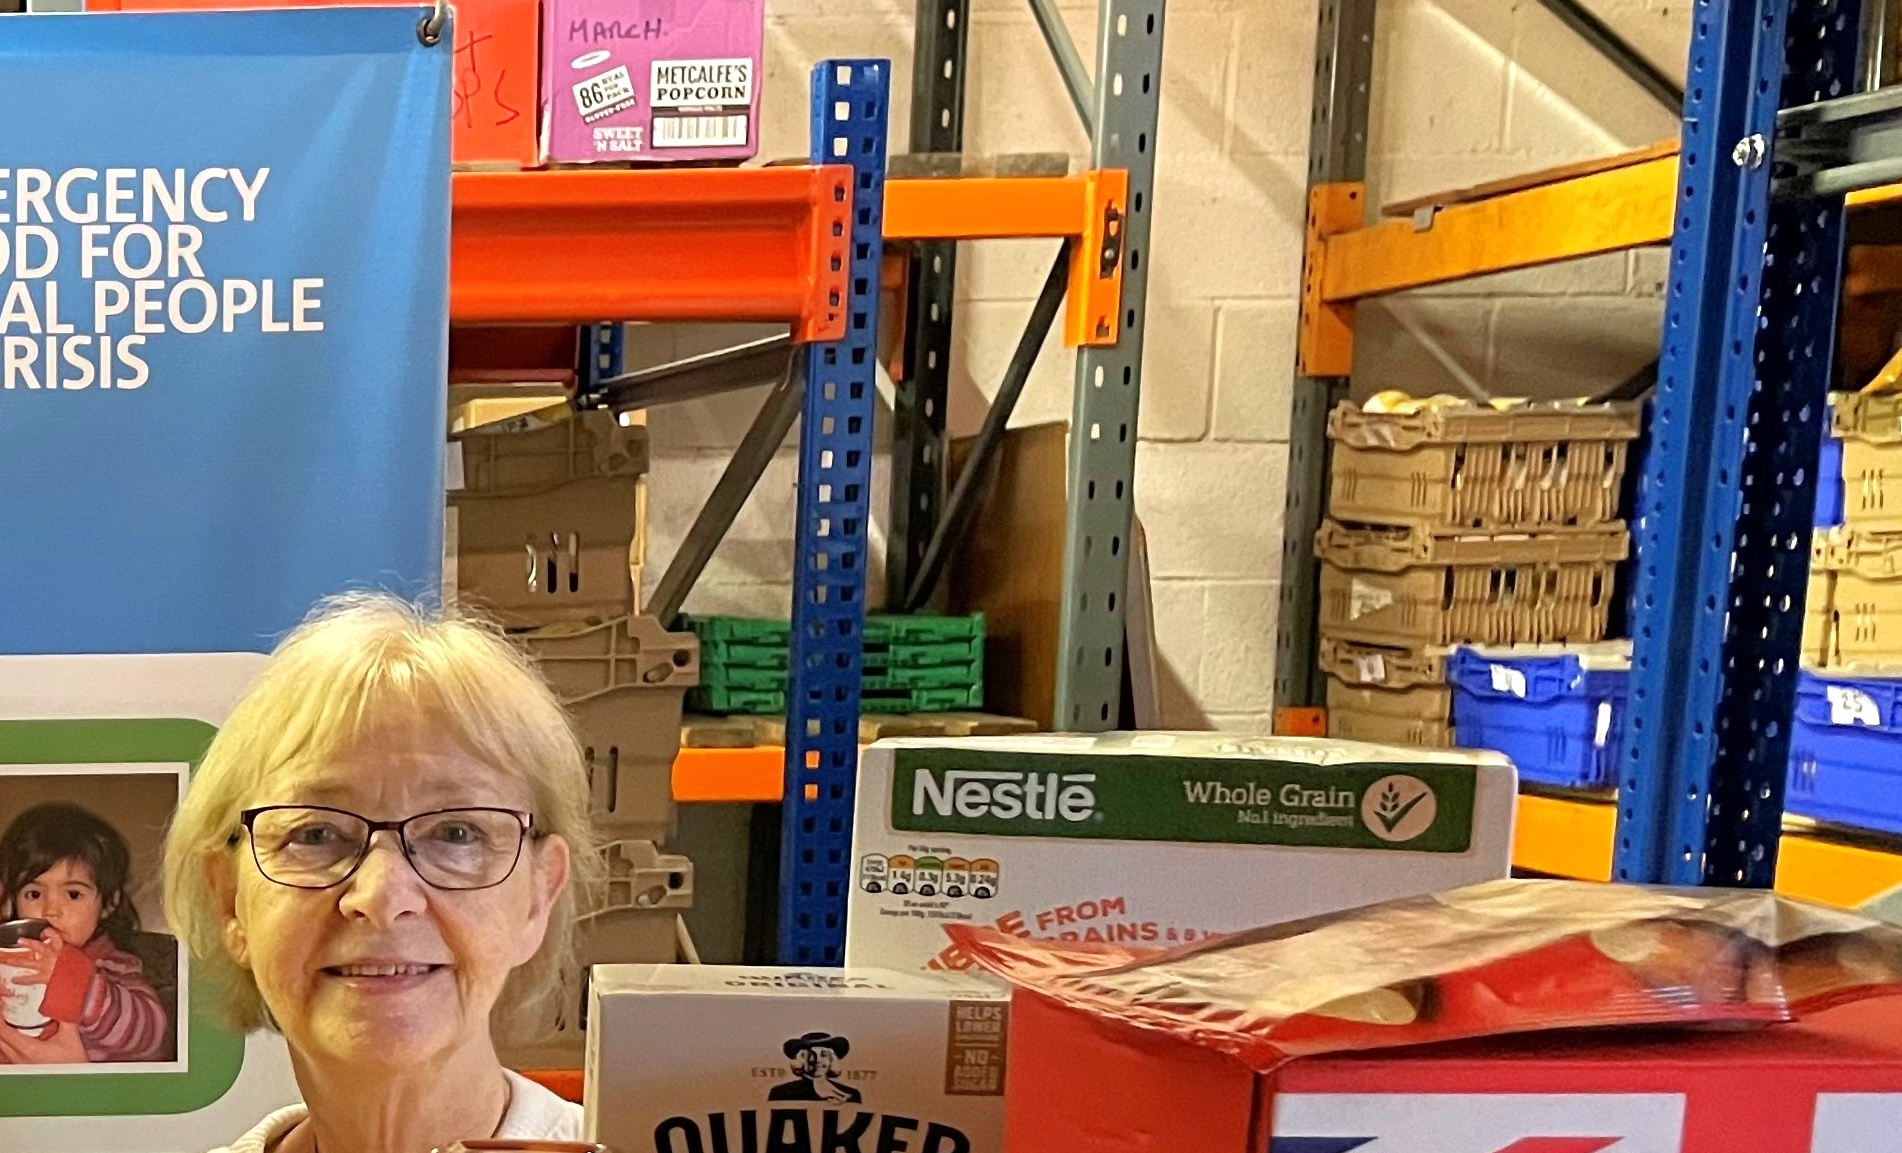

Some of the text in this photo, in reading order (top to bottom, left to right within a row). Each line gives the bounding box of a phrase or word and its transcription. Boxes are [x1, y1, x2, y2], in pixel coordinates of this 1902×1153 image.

[656, 64, 748, 85] METCALFE'S
[579, 82, 604, 109] 86
[656, 86, 746, 101] POPCORN
[80, 224, 205, 279] FOR
[94, 278, 325, 334] PEOPLE
[1183, 779, 1356, 808] Whole Grain
[1271, 810, 1355, 828] ingredient
[1035, 896, 1126, 931] FROM
